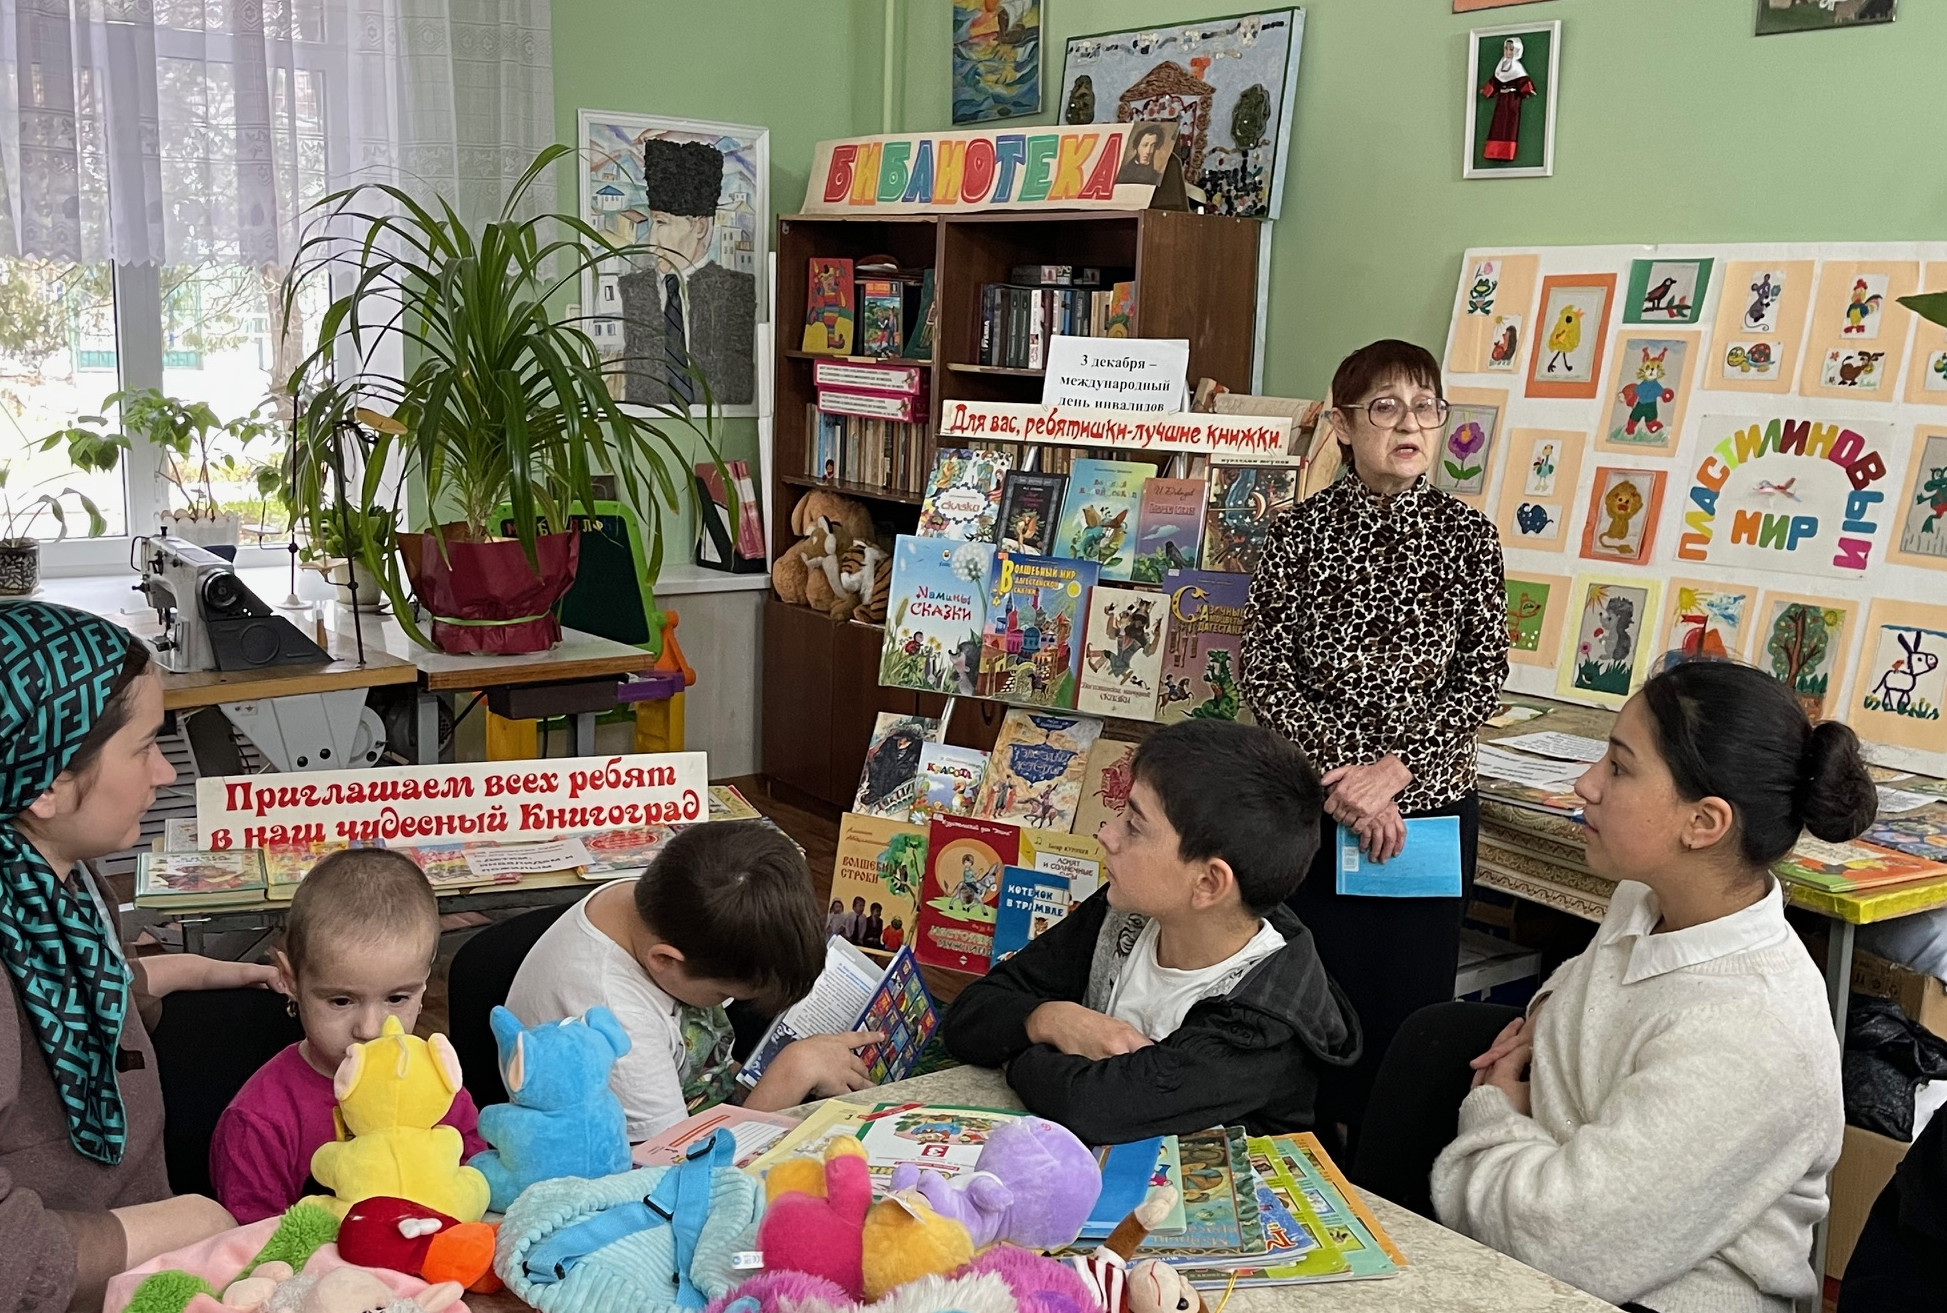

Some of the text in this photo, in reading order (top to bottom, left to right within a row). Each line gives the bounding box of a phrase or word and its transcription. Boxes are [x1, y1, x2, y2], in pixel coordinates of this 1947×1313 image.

[824, 132, 1123, 205] БИБЛИОТЕКА
[1080, 354, 1088, 366] 3
[1091, 356, 1146, 372] декабря
[1060, 376, 1171, 392] международный
[1058, 397, 1165, 412] день инвалидов
[950, 403, 987, 435] Для
[989, 414, 1020, 436] вас,
[1730, 509, 1819, 551] МИР
[1001, 560, 1076, 593] ВОЛШЕБНЫЙ МИР
[910, 602, 972, 621] СКАЗКИ
[926, 762, 973, 780] КРАСОТА
[225, 756, 677, 817] Приглашаем всех ребят
[210, 789, 701, 851] в наш чудесный Книгоград
[840, 867, 879, 884] СТРОКИ
[1050, 862, 1094, 877] СОЛНЕЧНЫЕ
[1006, 898, 1013, 907] В
